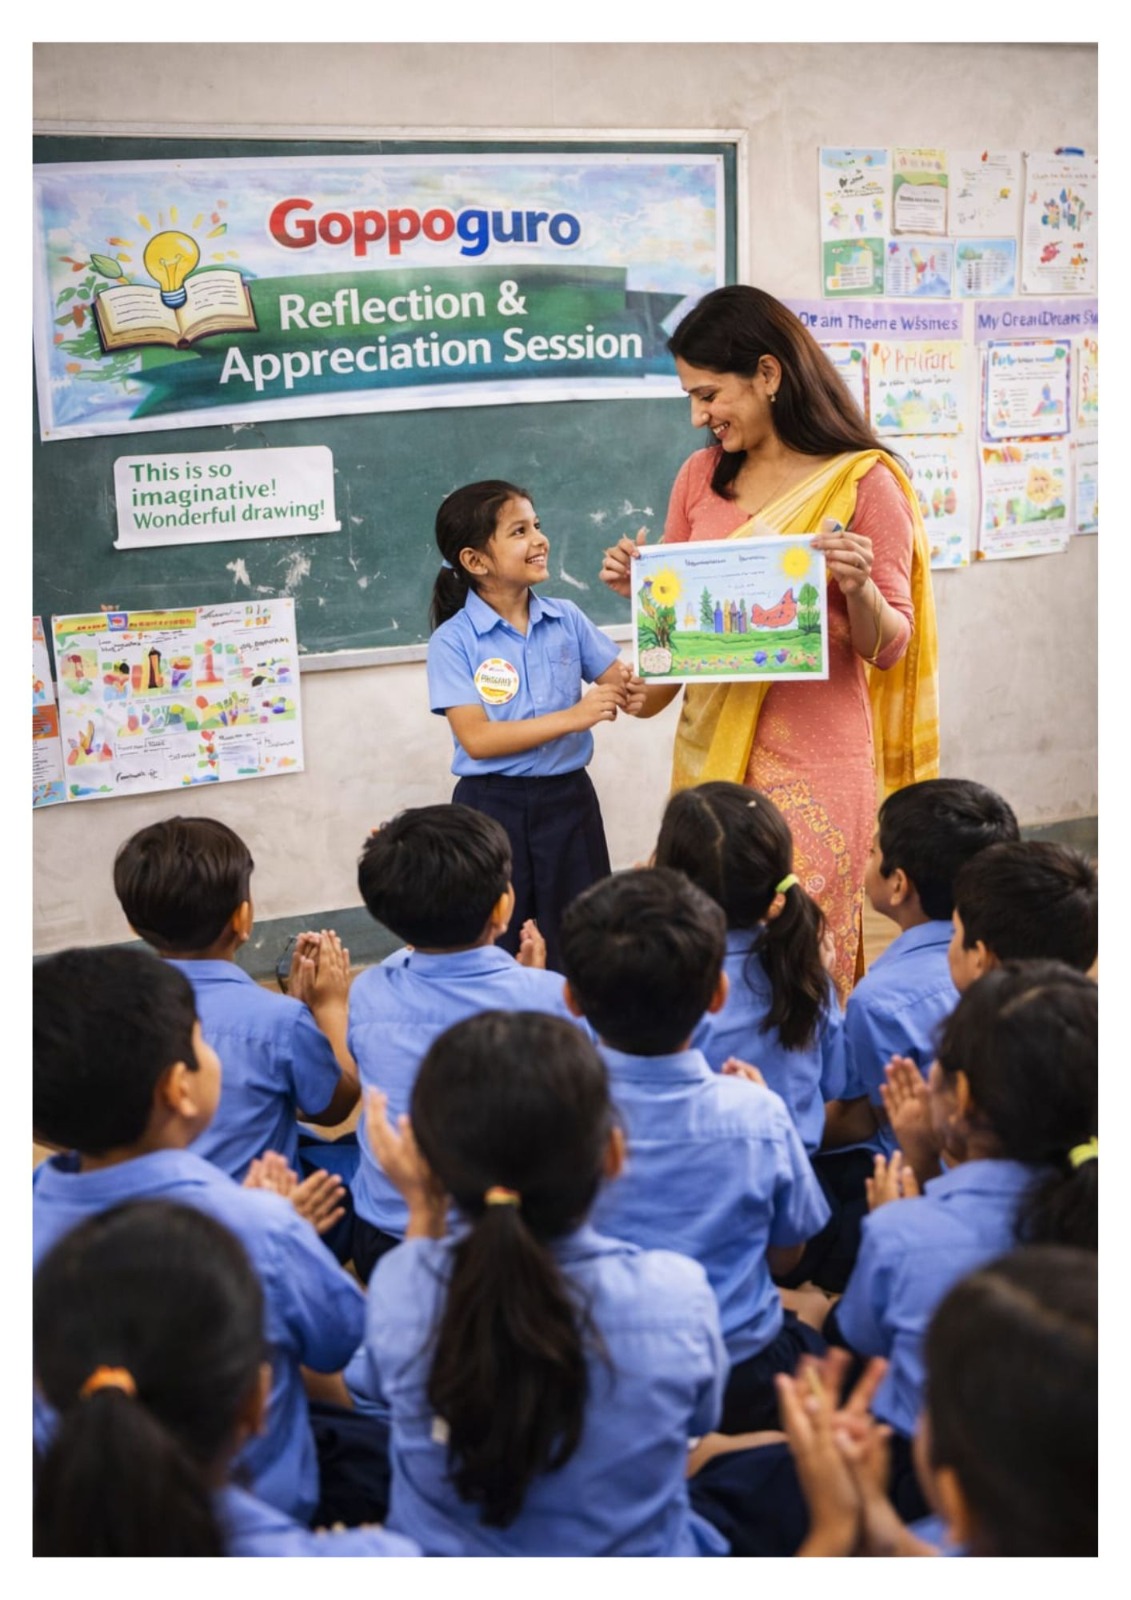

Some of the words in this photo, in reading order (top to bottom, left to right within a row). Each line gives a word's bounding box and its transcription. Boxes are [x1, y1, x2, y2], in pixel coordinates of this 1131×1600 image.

[268, 198, 581, 257] Goppoguro
[279, 285, 486, 330] Reflection
[497, 279, 528, 316] &
[978, 313, 1000, 331] My
[219, 332, 492, 391] Appreciation
[503, 325, 643, 363] Session
[129, 462, 180, 482] This
[186, 461, 203, 480] is
[208, 463, 232, 478] so
[132, 478, 277, 508] imaginative!
[132, 506, 236, 530] Wonderful
[241, 499, 325, 521] drawing!
